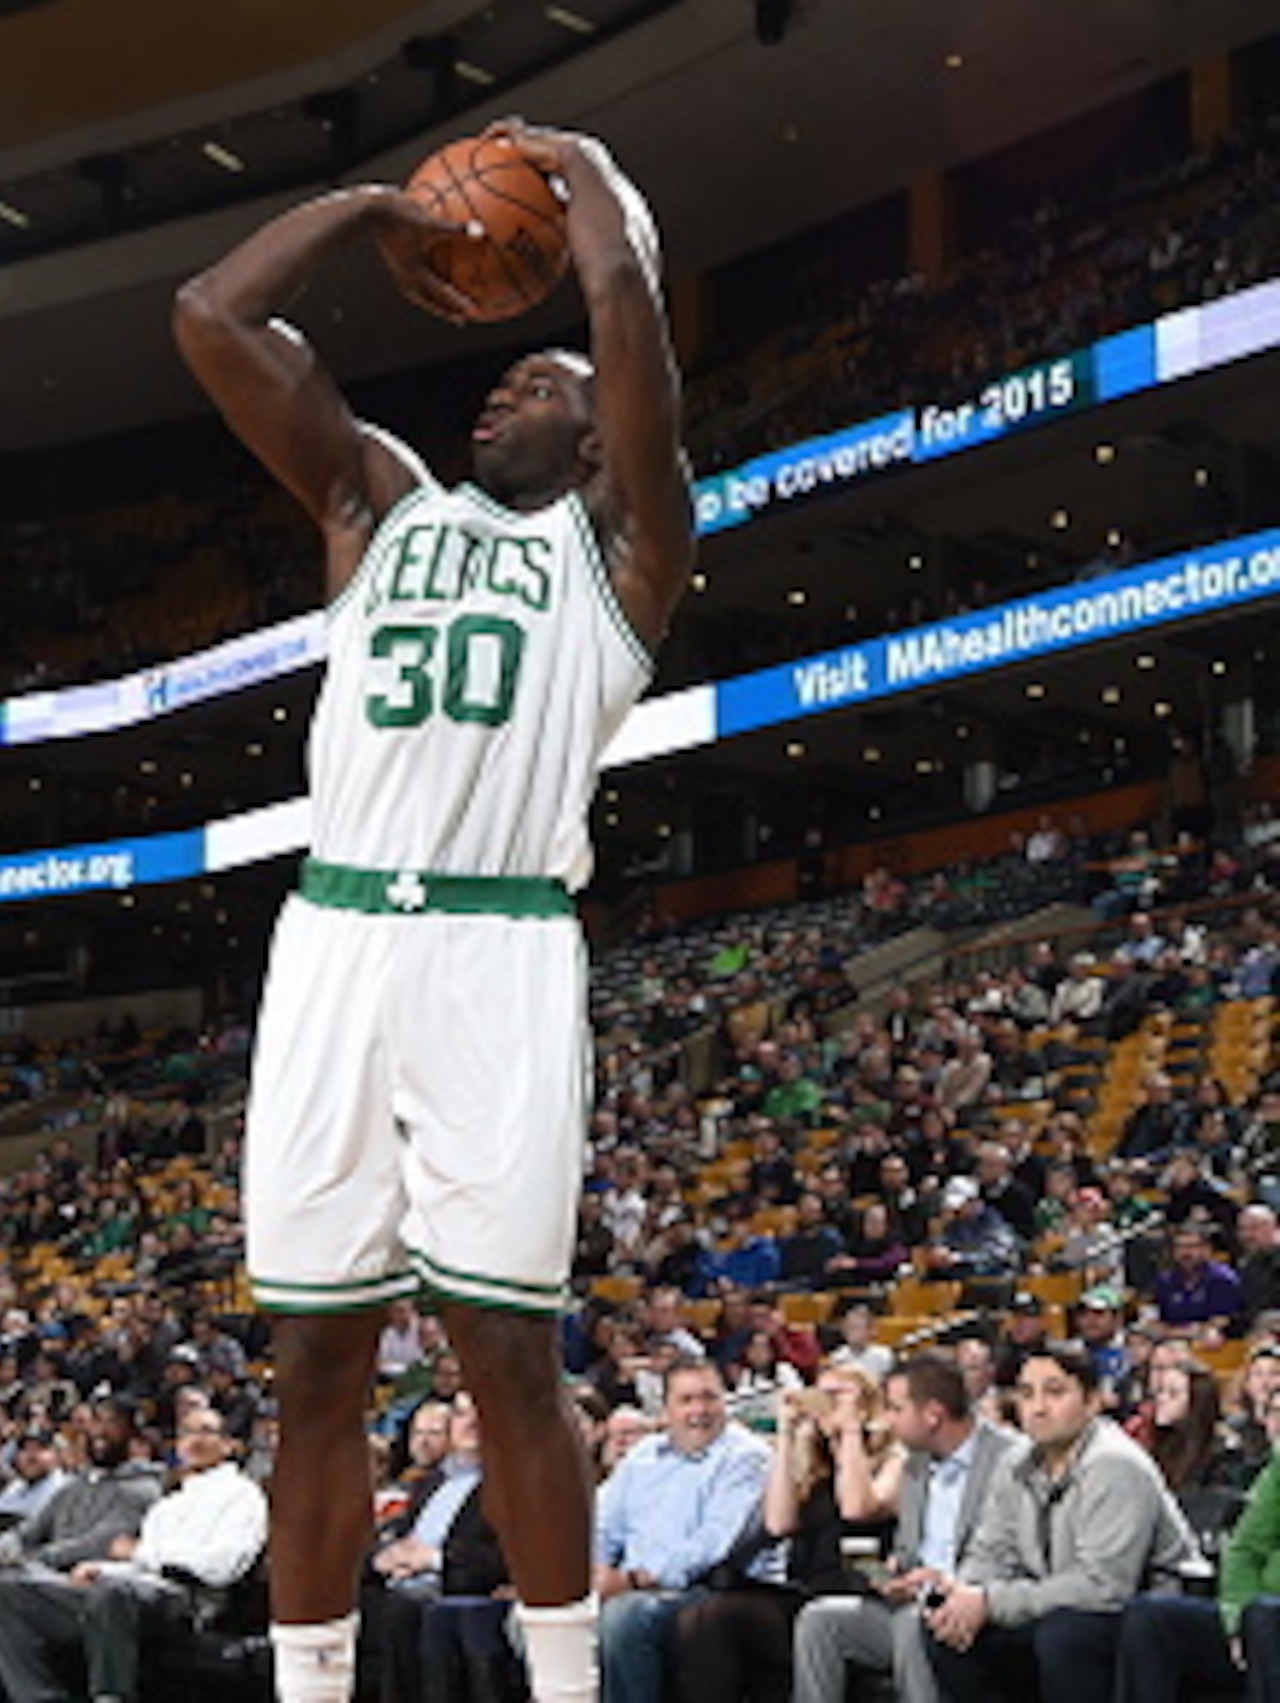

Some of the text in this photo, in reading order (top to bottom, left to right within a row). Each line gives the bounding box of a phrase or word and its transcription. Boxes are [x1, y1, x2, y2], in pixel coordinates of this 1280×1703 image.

[724, 475, 769, 508] be
[775, 416, 916, 496] covered
[921, 404, 973, 447] for
[980, 359, 1074, 428] 2015
[365, 613, 526, 729] 30
[793, 650, 869, 706] Visit
